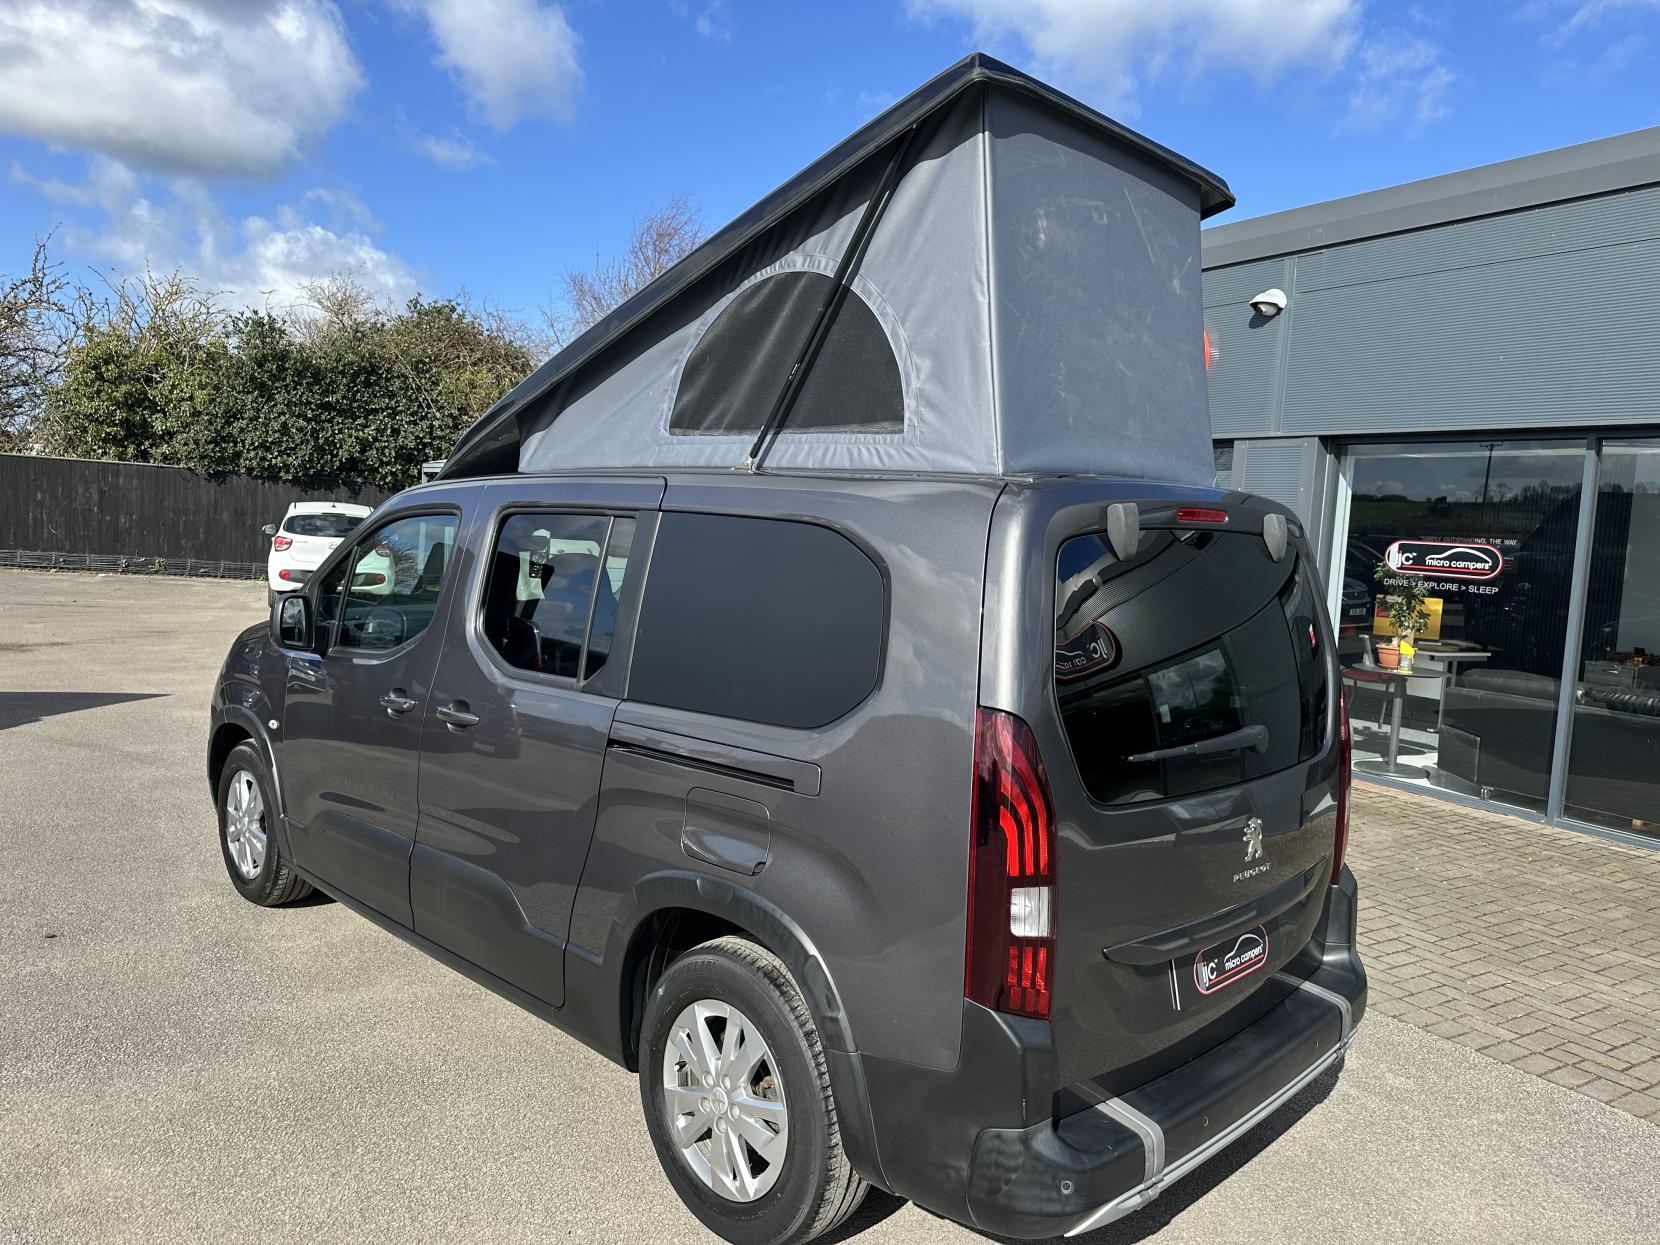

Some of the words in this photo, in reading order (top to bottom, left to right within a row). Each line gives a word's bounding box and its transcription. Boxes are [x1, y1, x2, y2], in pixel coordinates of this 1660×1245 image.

[1425, 558, 1449, 567] micro
[1450, 560, 1490, 570] campers
[1384, 578, 1409, 587] DRIVE
[1418, 582, 1459, 591] EXPLORE
[1468, 585, 1499, 595] SLEEP
[1233, 861, 1272, 883] PEUGEOT
[1225, 956, 1241, 971] micro
[1241, 946, 1263, 962] campers
